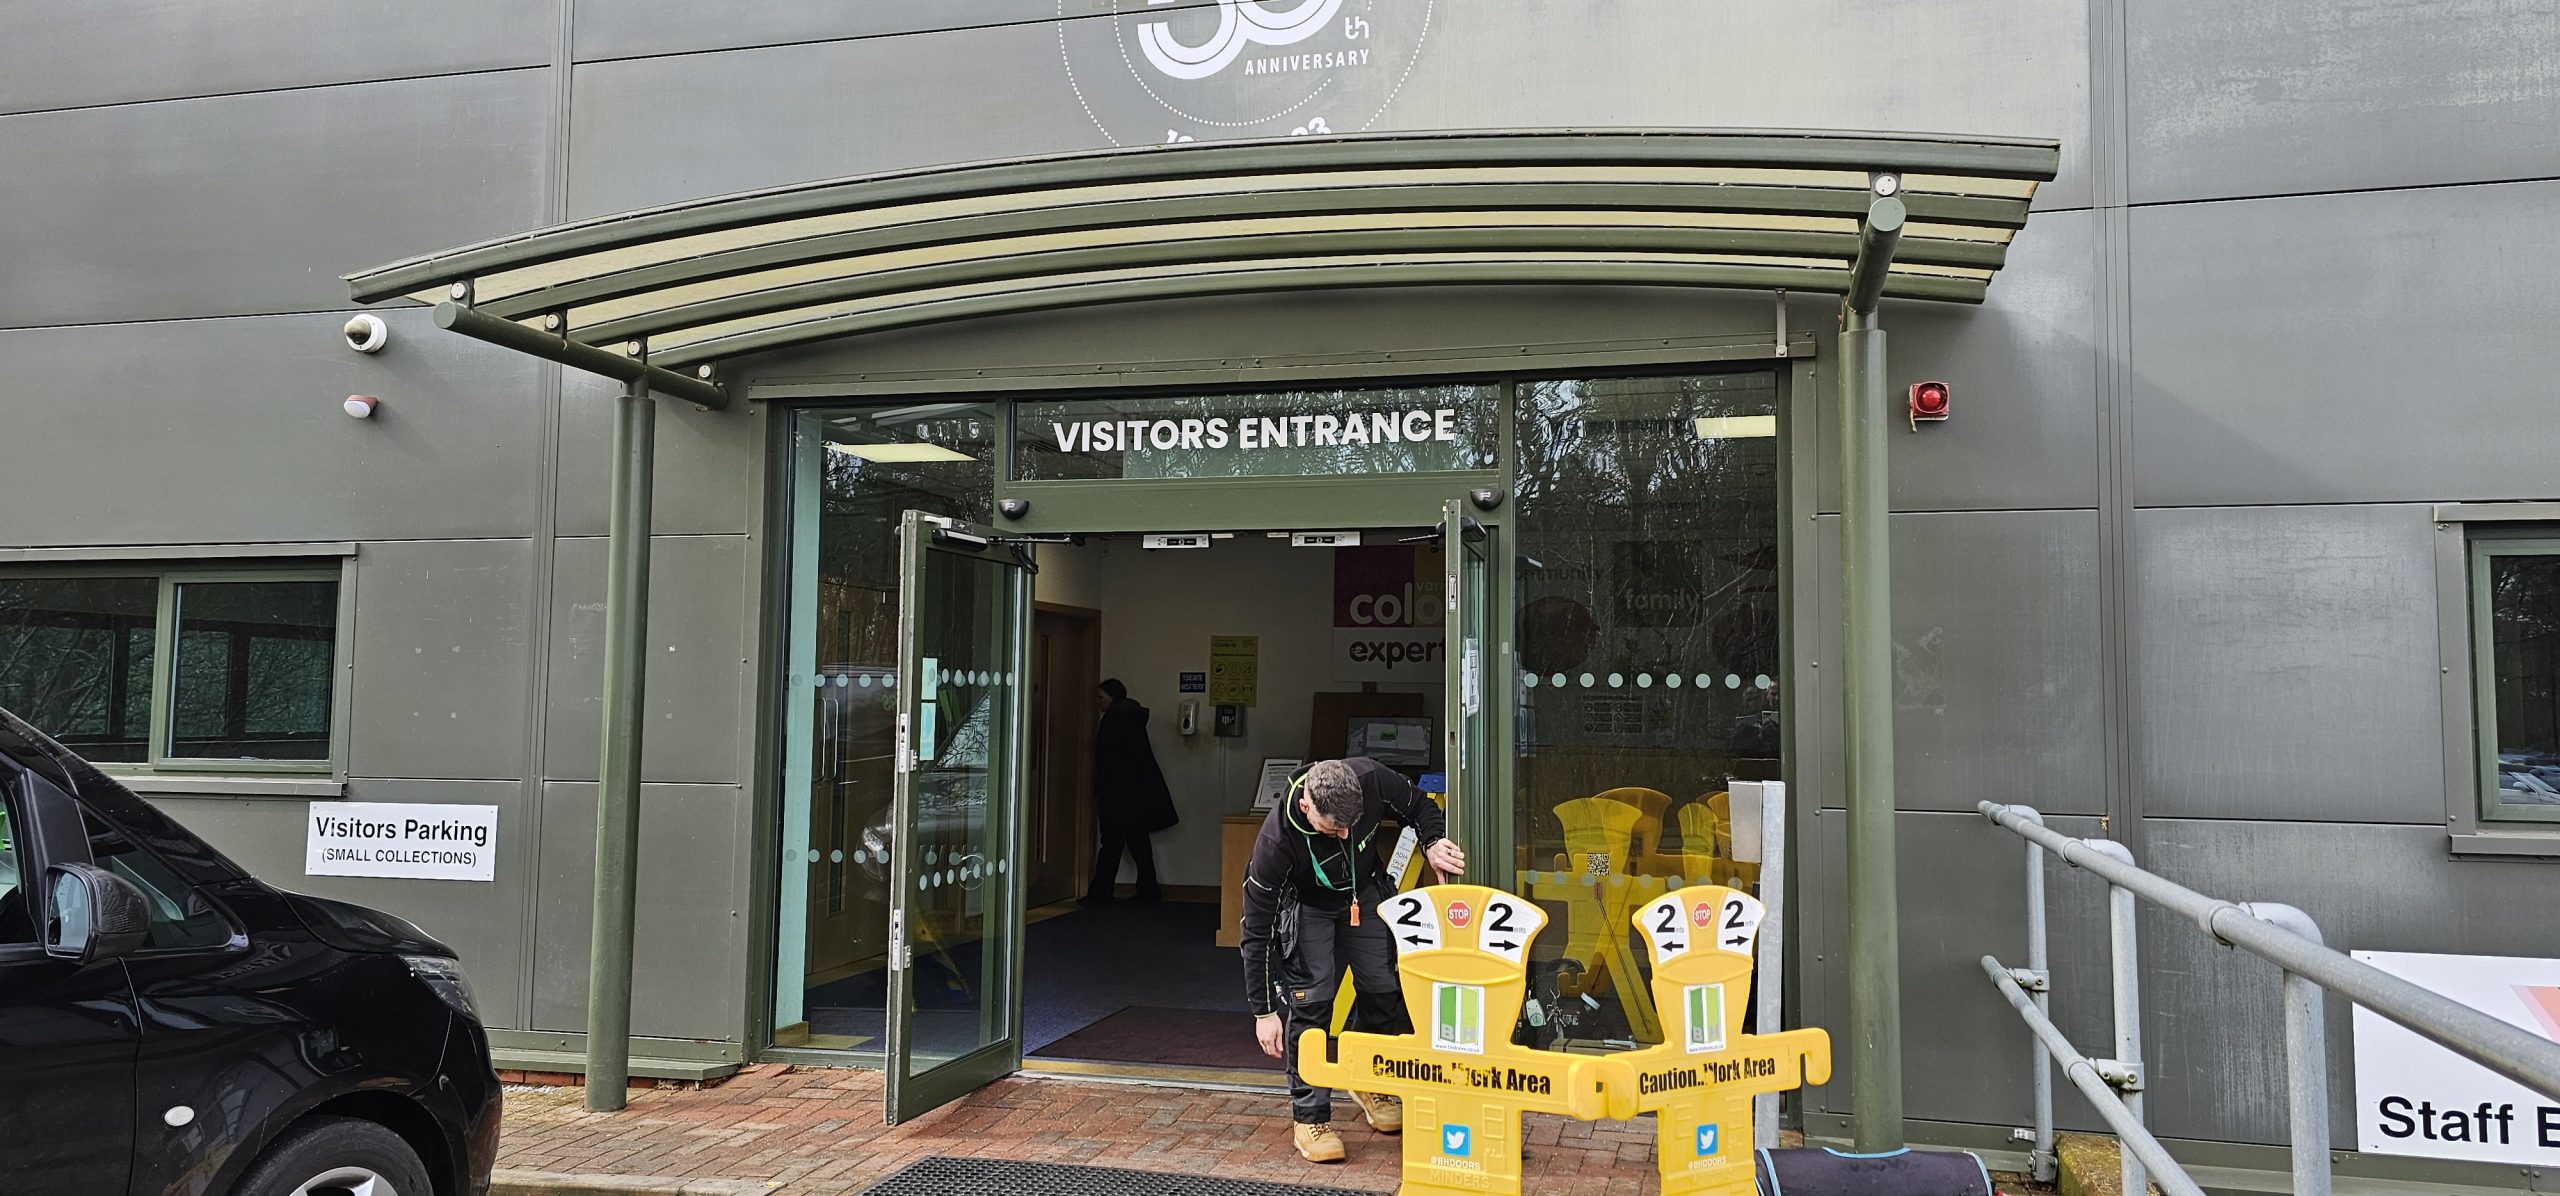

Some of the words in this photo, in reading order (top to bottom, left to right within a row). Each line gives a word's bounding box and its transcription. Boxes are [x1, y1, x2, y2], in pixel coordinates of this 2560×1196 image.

[1345, 16, 1369, 39] th
[1245, 49, 1369, 75] ANNIVERSARY
[1054, 417, 1228, 453] VISITORS
[1239, 409, 1456, 449] ENTRANCE
[316, 817, 396, 839] Visitors
[404, 819, 487, 847] Parking
[322, 848, 371, 863] (SMALL
[375, 850, 477, 868] COLLECTIONS)
[1397, 898, 1422, 927] 2
[1449, 908, 1469, 920] STOP
[1488, 903, 1513, 932] 2
[1656, 904, 1676, 933] 2
[1694, 911, 1711, 921] STOP
[1725, 900, 1744, 929] 2
[1506, 1068, 1551, 1094] Area
[1744, 1057, 1776, 1079] Area
[2379, 1096, 2514, 1145] Staff
[1430, 1156, 1481, 1171] @BHDOORS
[1430, 1168, 1490, 1189] MINDERS
